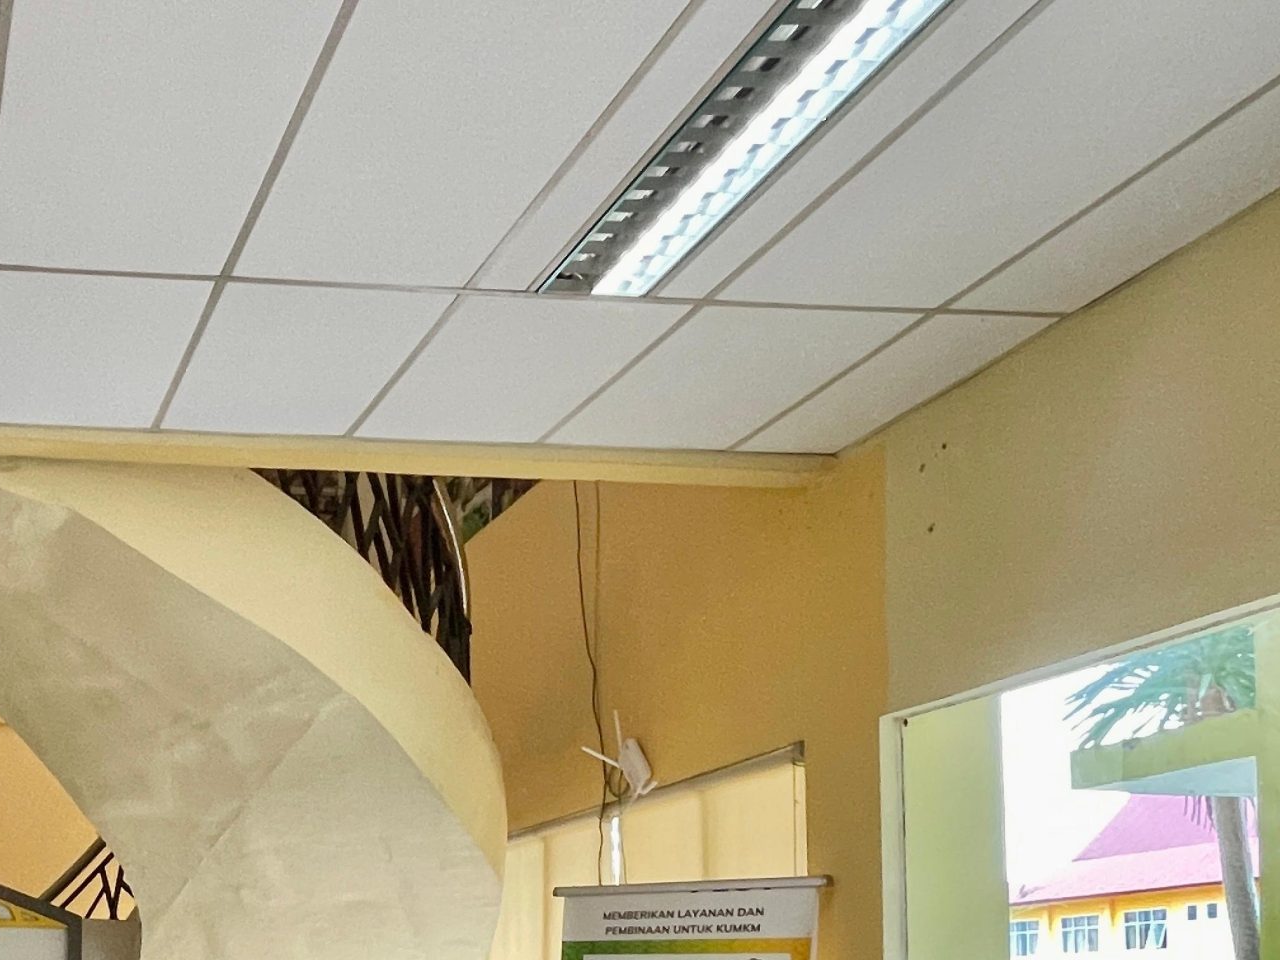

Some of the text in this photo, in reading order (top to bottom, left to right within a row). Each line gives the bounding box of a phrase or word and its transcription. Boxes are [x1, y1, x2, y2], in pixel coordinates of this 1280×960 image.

[603, 907, 765, 921] MEMBERIKAN LAYANAN DAN
[605, 923, 761, 936] PEMBINAAN UNTUK KUMKM
